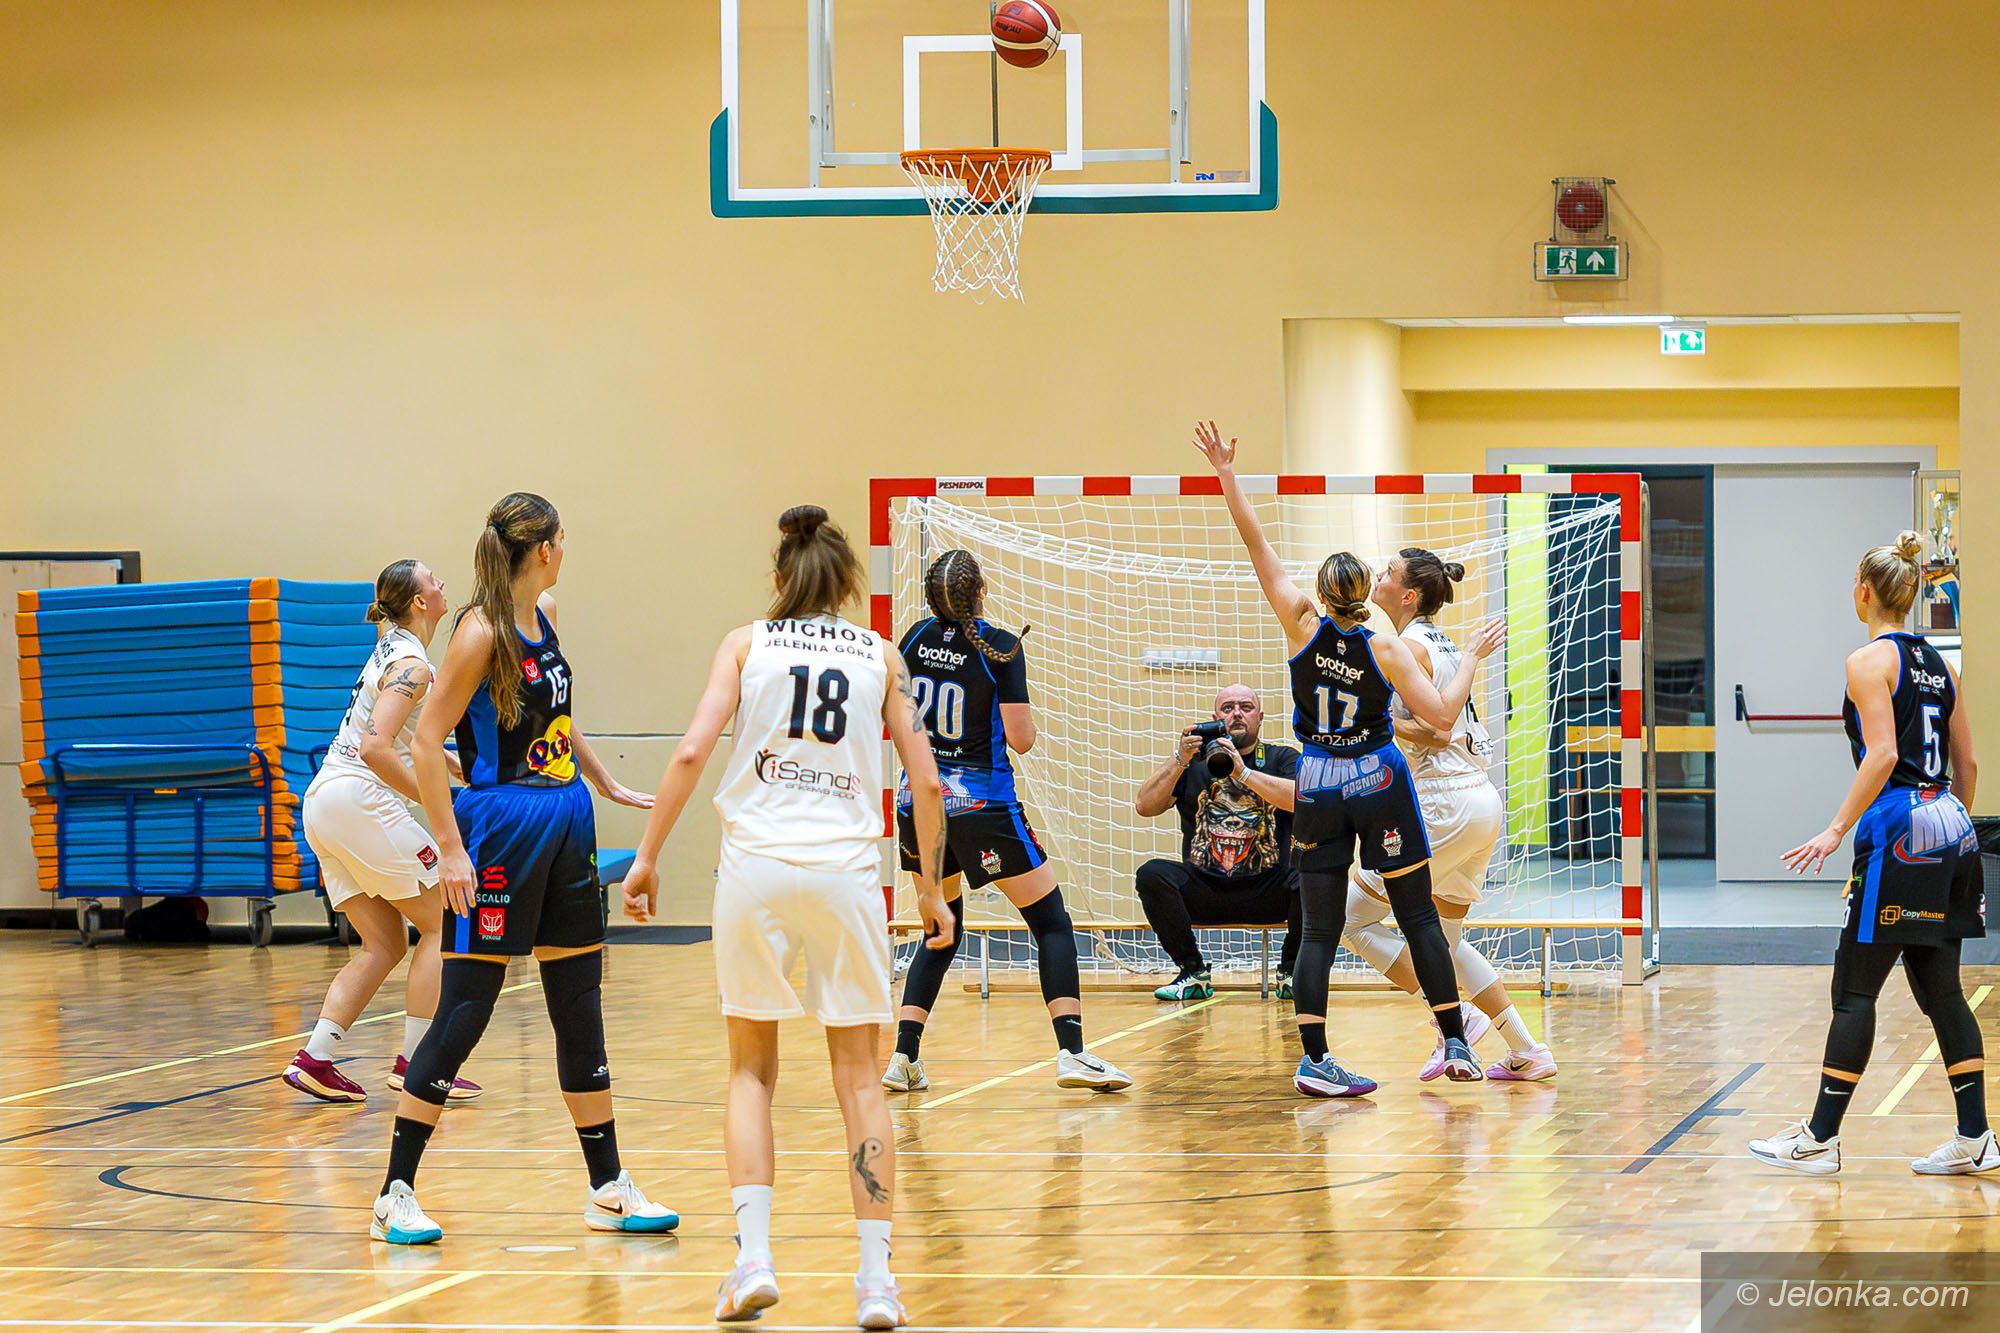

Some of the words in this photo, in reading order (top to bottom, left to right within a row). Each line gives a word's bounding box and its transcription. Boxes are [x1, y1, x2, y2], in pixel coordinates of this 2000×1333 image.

[765, 638, 828, 652] JELENIA
[918, 644, 967, 665] brother
[930, 661, 944, 670] your
[944, 663, 956, 671] side
[1315, 653, 1364, 680] brother
[546, 664, 568, 709] 15
[788, 665, 849, 744] 18
[912, 676, 964, 740] 20
[1314, 685, 1360, 733] 17
[1921, 704, 1941, 778] 5
[476, 893, 510, 904] SCALIO
[1901, 909, 1945, 920] CopyMaster
